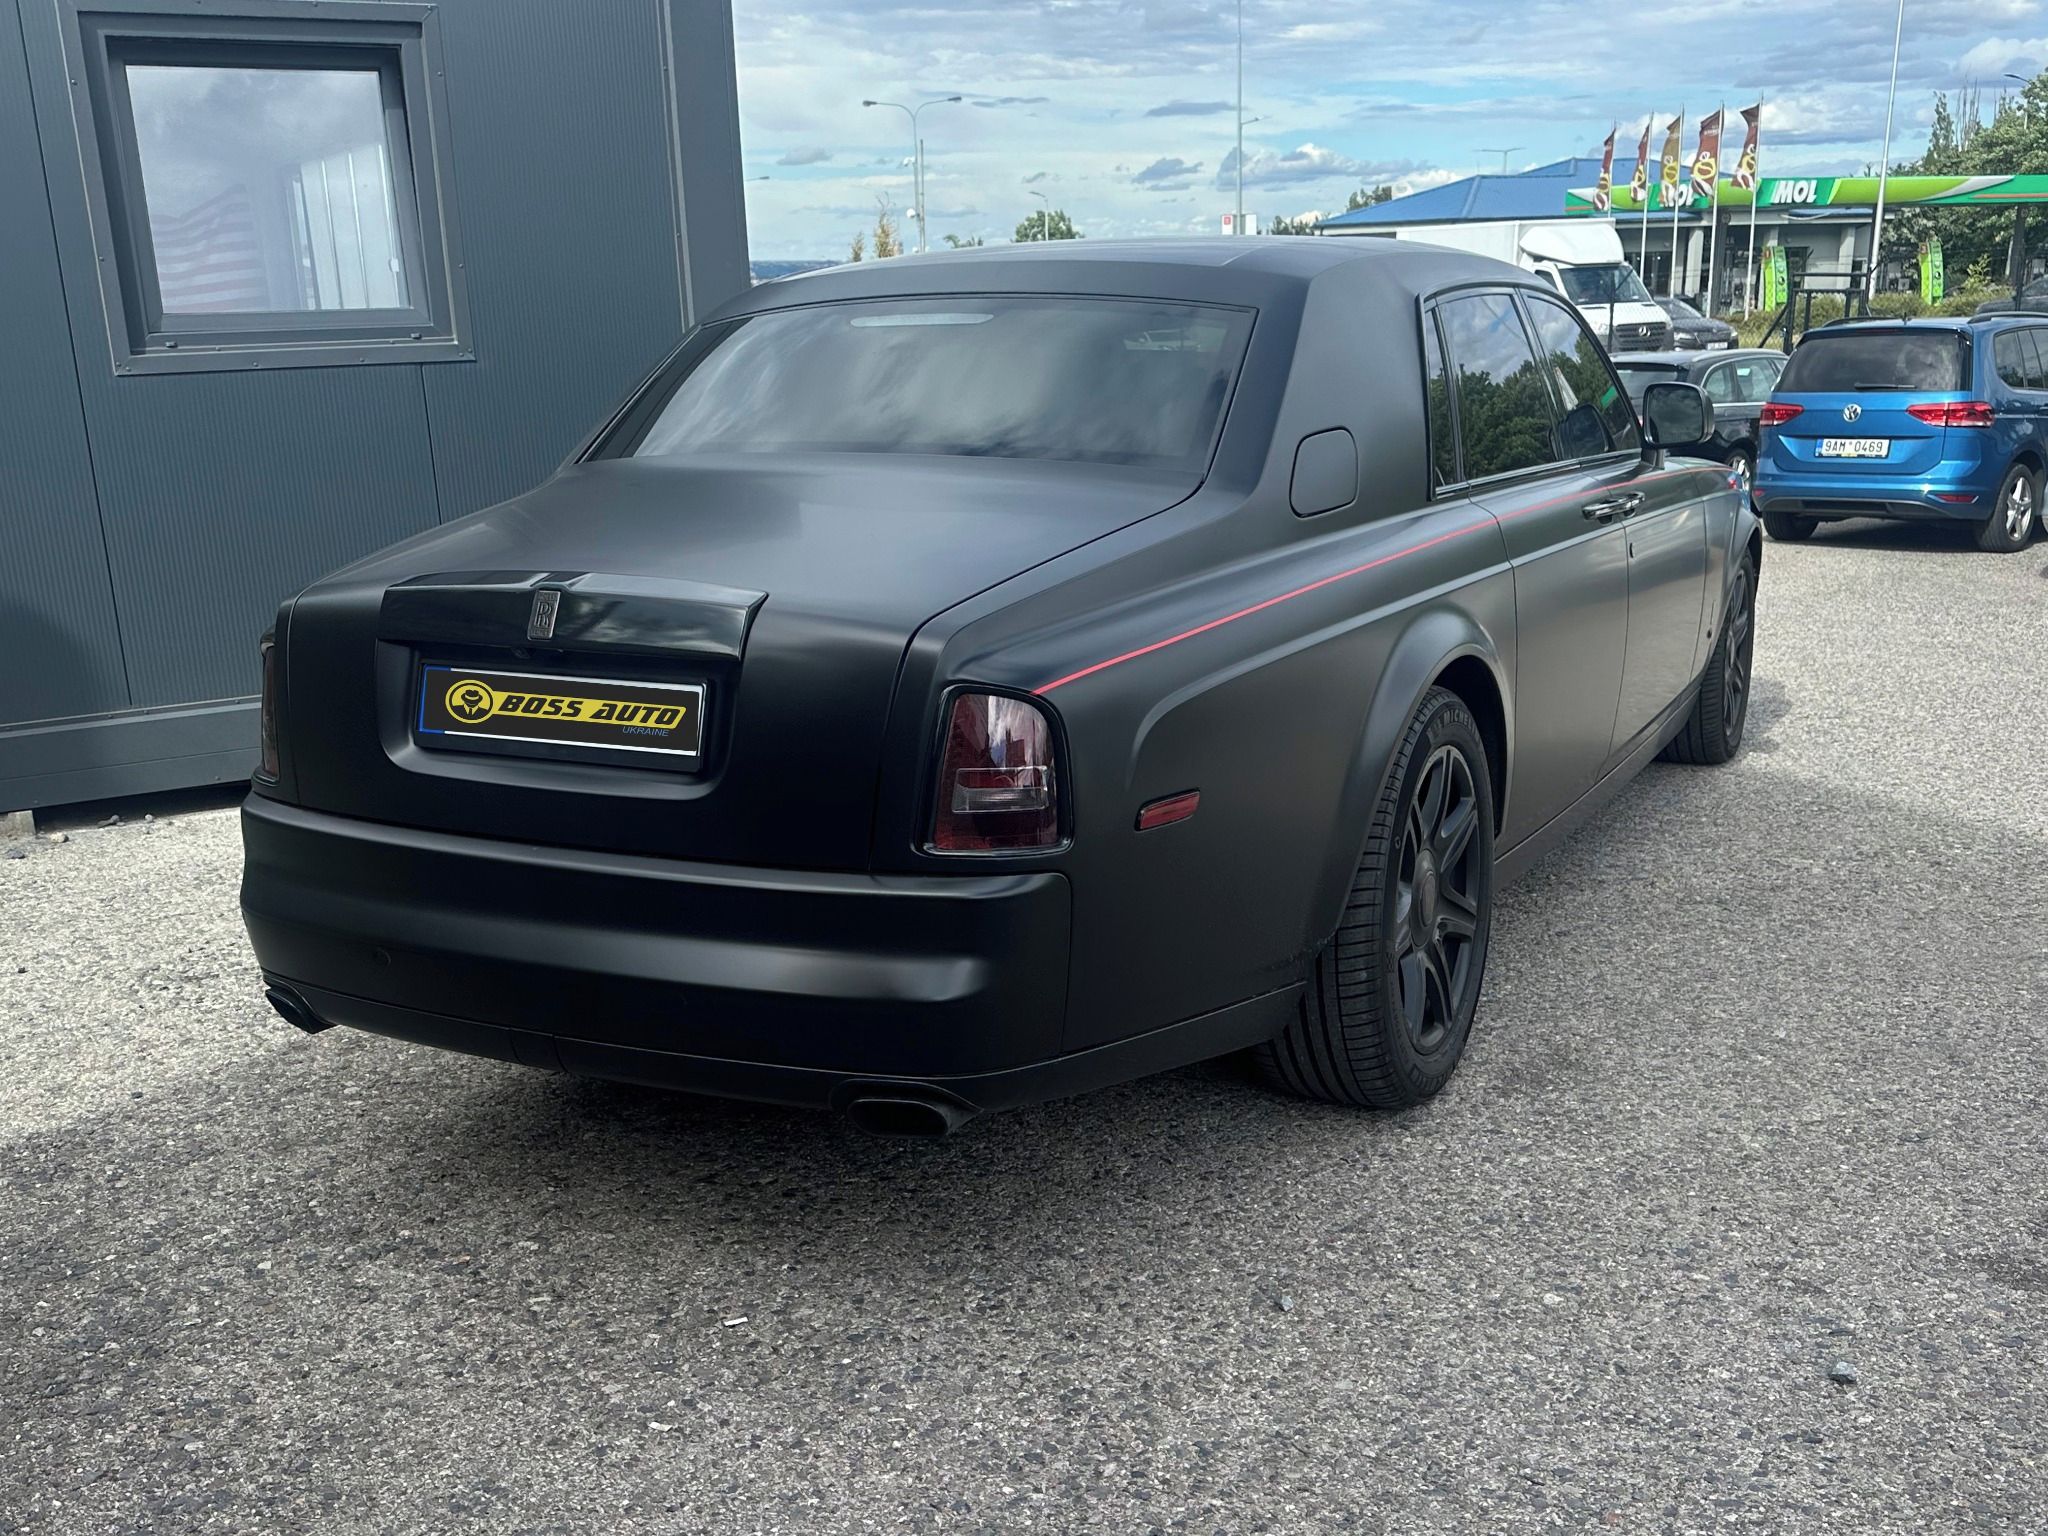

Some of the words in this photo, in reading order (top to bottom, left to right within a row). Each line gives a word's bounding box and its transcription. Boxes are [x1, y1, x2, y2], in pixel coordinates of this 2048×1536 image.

[1774, 179, 1817, 204] MOL
[1825, 440, 1846, 452] 9AM
[1854, 441, 1883, 453] 0469
[497, 694, 584, 718] BOSS
[589, 702, 681, 725] AUTO
[621, 726, 671, 738] UKRAINE
